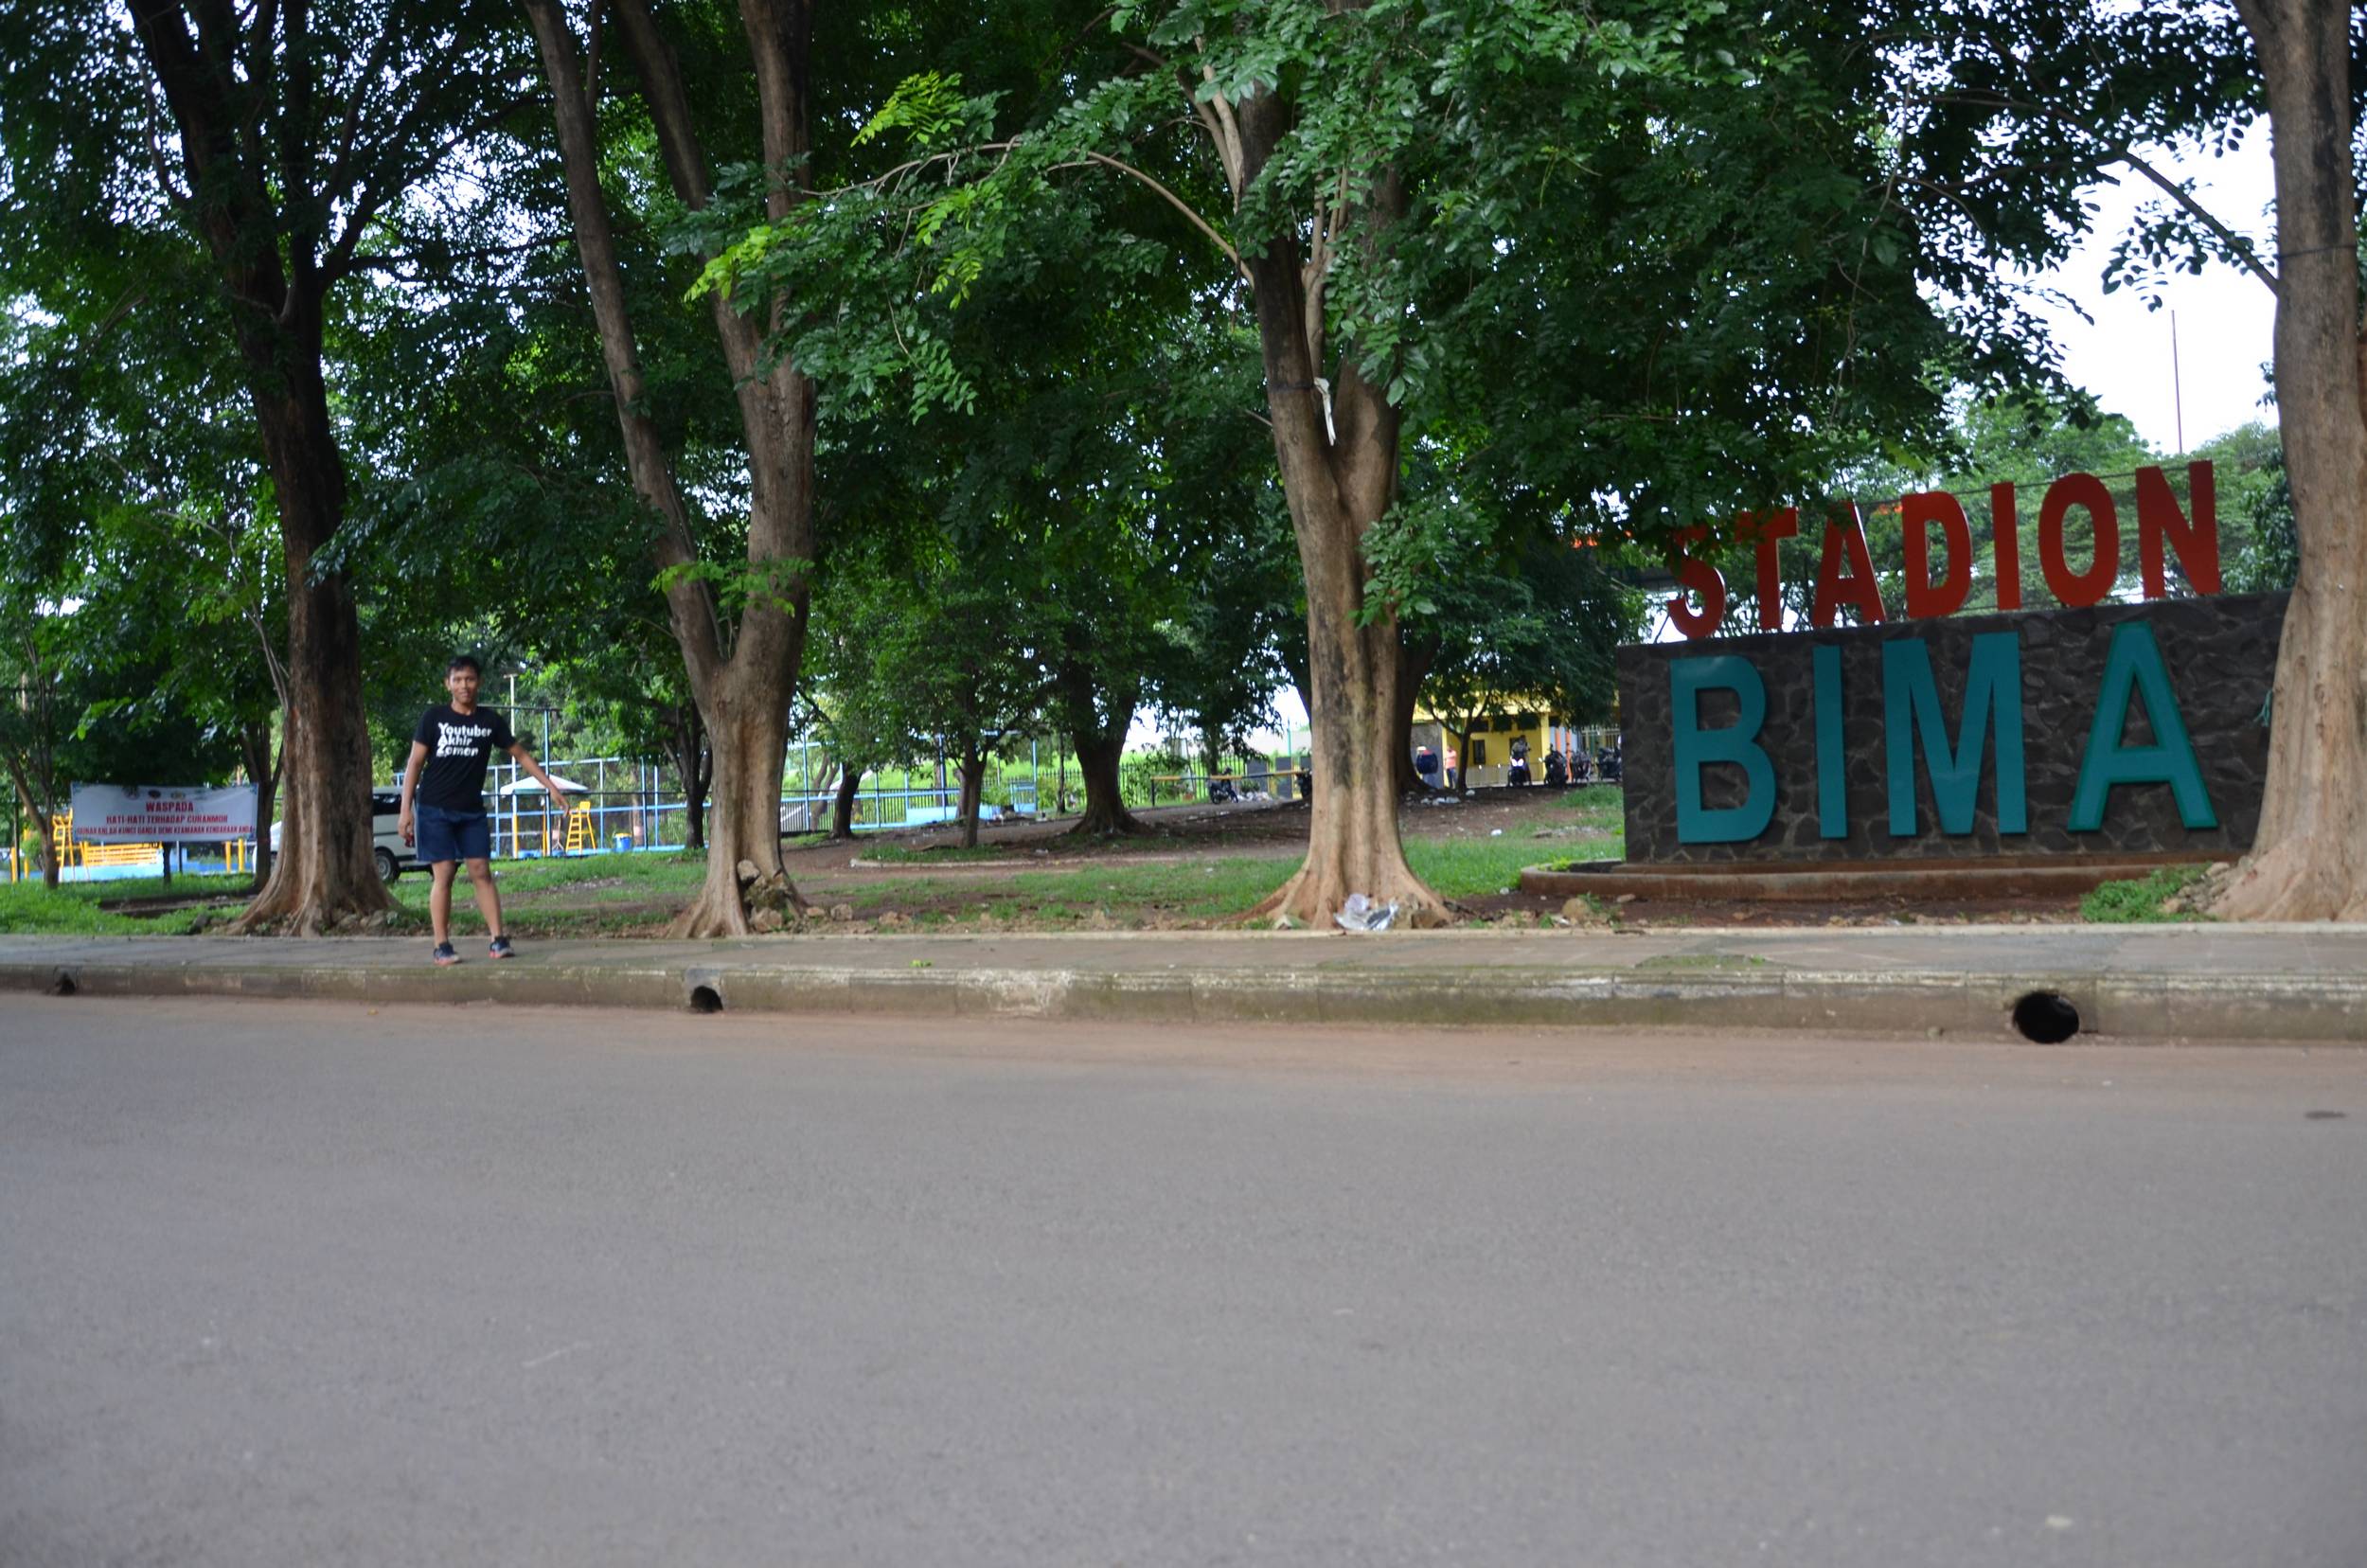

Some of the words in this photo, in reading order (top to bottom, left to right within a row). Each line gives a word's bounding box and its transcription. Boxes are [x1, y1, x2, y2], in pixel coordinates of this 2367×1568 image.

[1665, 459, 2222, 638] STADION
[437, 722, 492, 738] Youtuber
[1669, 620, 2218, 844] BIMA
[437, 734, 472, 746] Akhir
[145, 801, 194, 811] WASPADA
[106, 814, 145, 824] HATI-HATI
[147, 814, 186, 824] TERHADAP
[187, 814, 228, 823] CURANMOR
